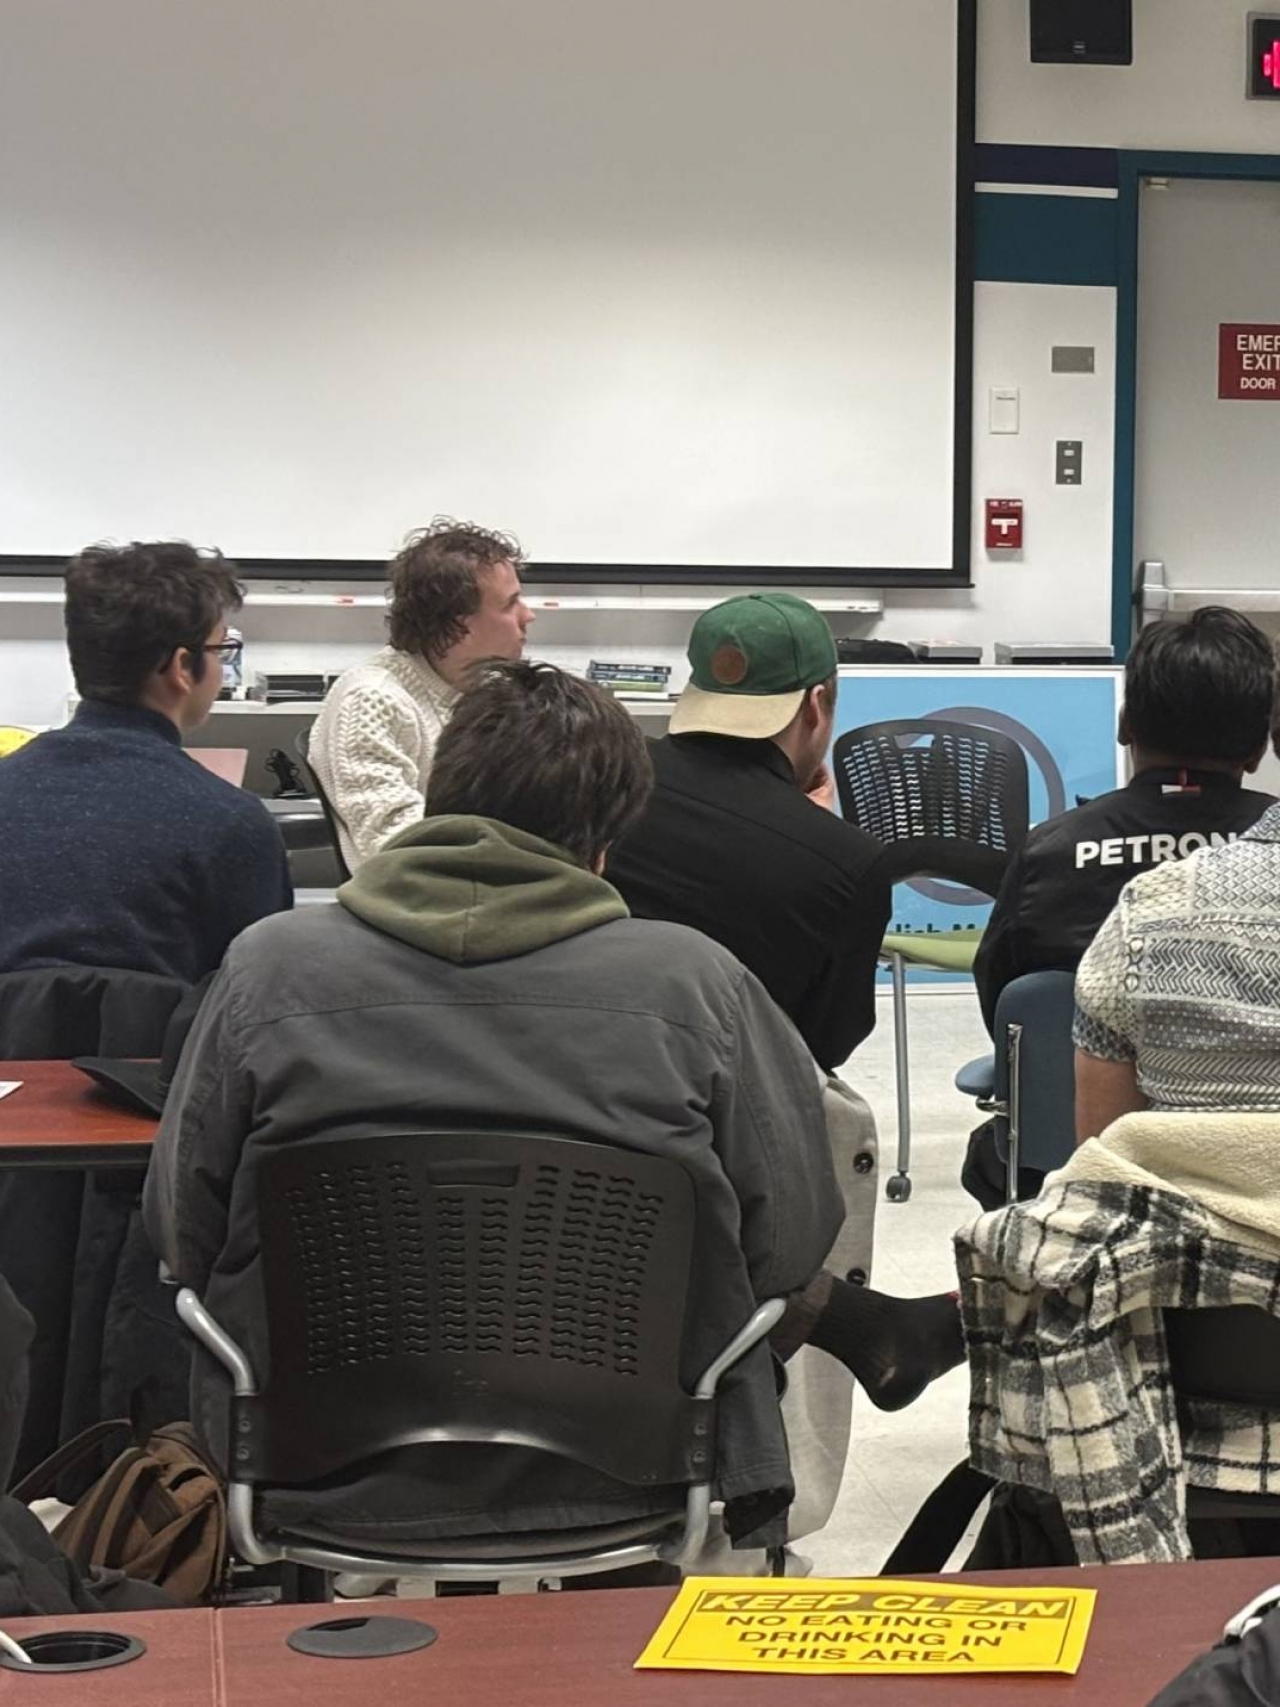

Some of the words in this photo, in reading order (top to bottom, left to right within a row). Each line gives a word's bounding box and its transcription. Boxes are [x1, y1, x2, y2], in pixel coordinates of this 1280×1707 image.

[1240, 377, 1276, 390] DOOR
[701, 1594, 861, 1610] KEEP
[872, 1595, 1066, 1616] CLEAN
[726, 1614, 788, 1627] NO
[800, 1614, 953, 1629] EATING
[967, 1619, 1028, 1632] OR
[738, 1630, 946, 1646] DRINKING
[961, 1634, 1002, 1647] IN
[752, 1647, 848, 1660] THIS
[858, 1650, 975, 1663] AREA
